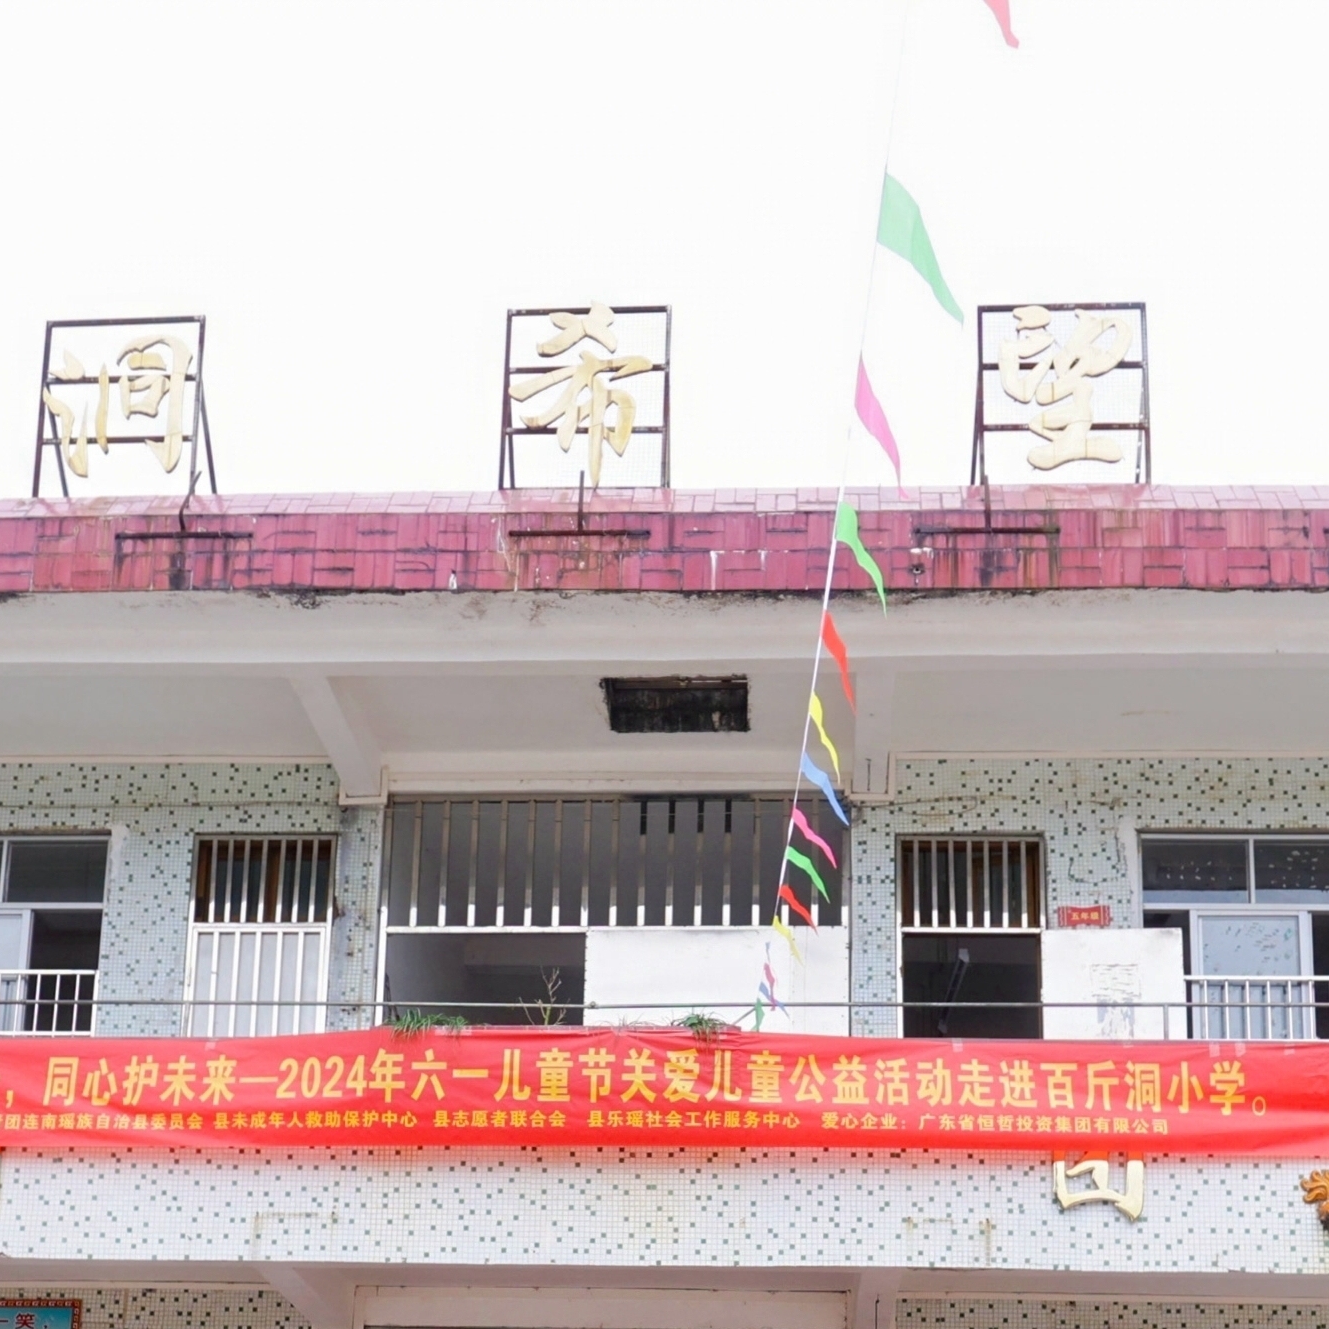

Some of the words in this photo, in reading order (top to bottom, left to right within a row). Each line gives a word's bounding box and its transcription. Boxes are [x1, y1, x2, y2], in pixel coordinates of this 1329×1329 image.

[1070, 911, 1099, 921] 五年级
[213, 1110, 418, 1129] 县未成年人救助保护中心
[434, 1109, 567, 1129] 县志愿者联合会
[587, 1109, 801, 1129] 县乐瑶社会工作服务中心
